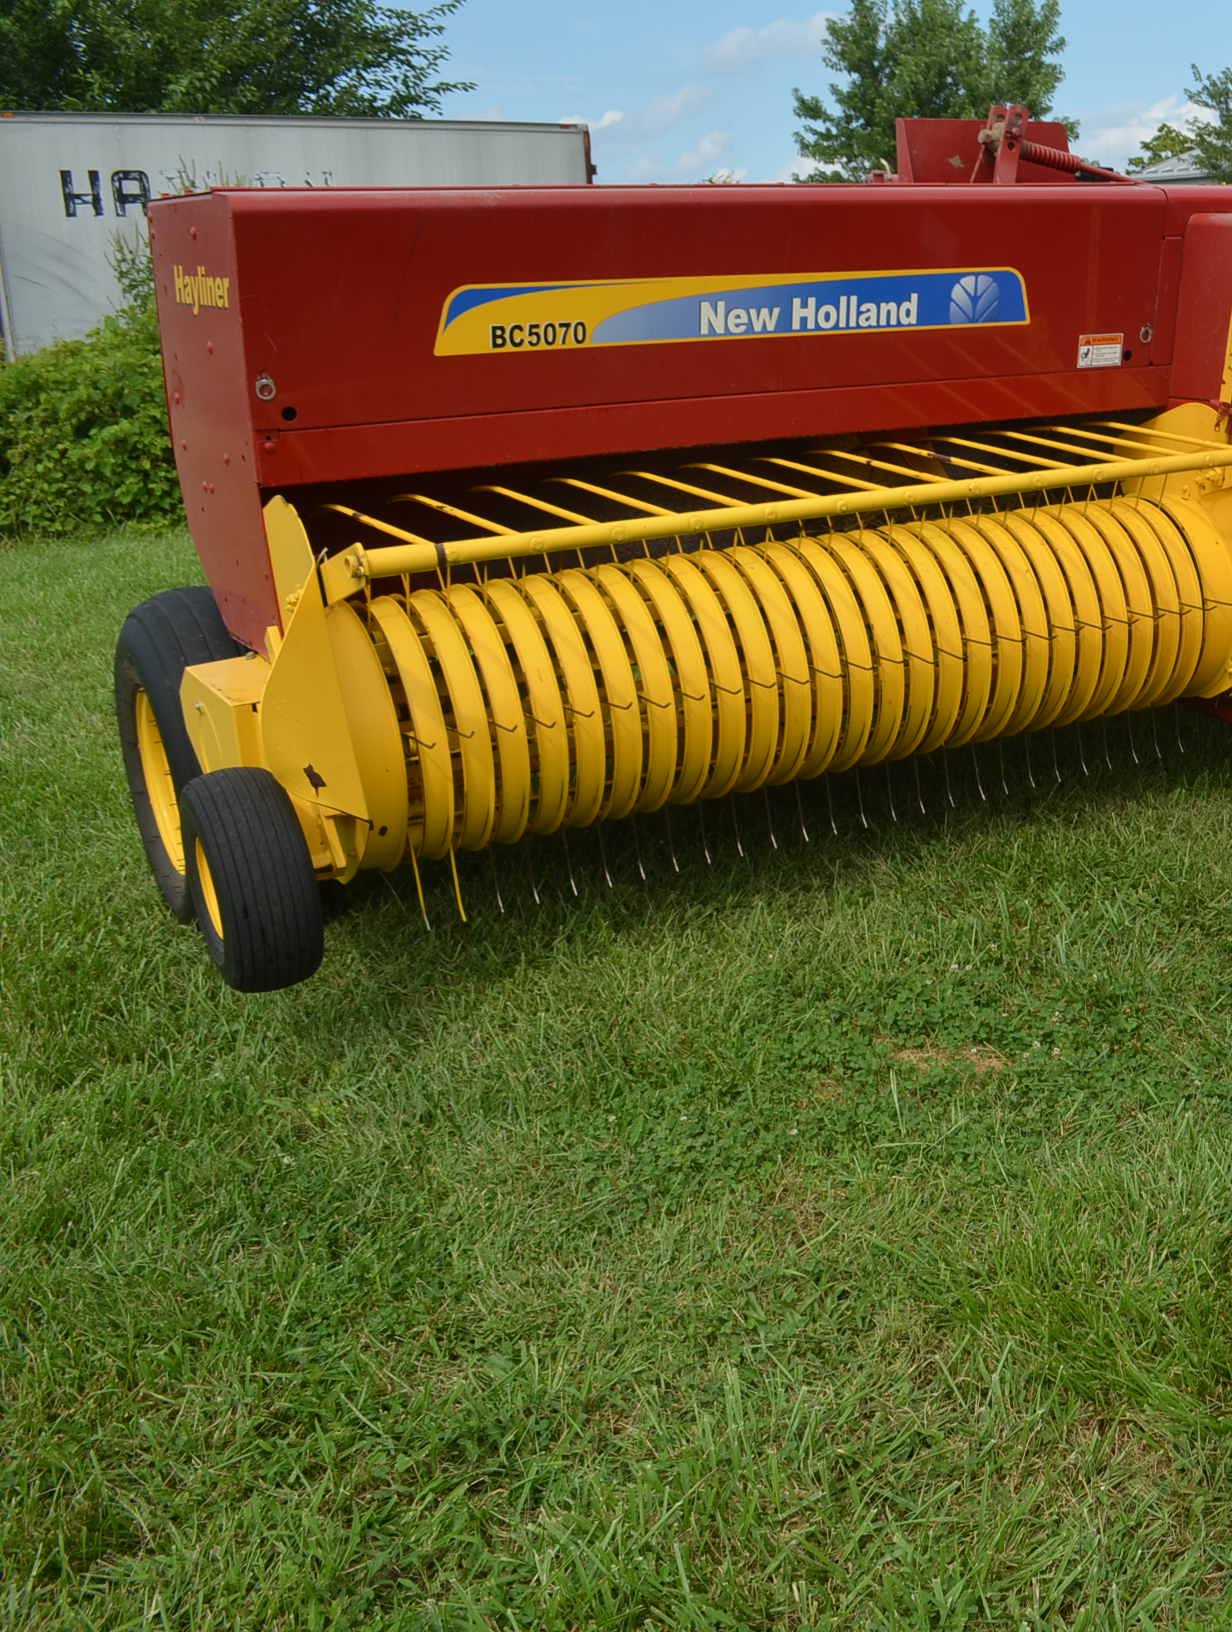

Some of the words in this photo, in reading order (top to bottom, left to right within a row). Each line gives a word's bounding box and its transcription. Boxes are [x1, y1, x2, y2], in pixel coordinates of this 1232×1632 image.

[173, 264, 230, 315] Hayliner
[490, 320, 587, 349] BC5070
[700, 300, 781, 336] New
[791, 292, 919, 331] Holland
